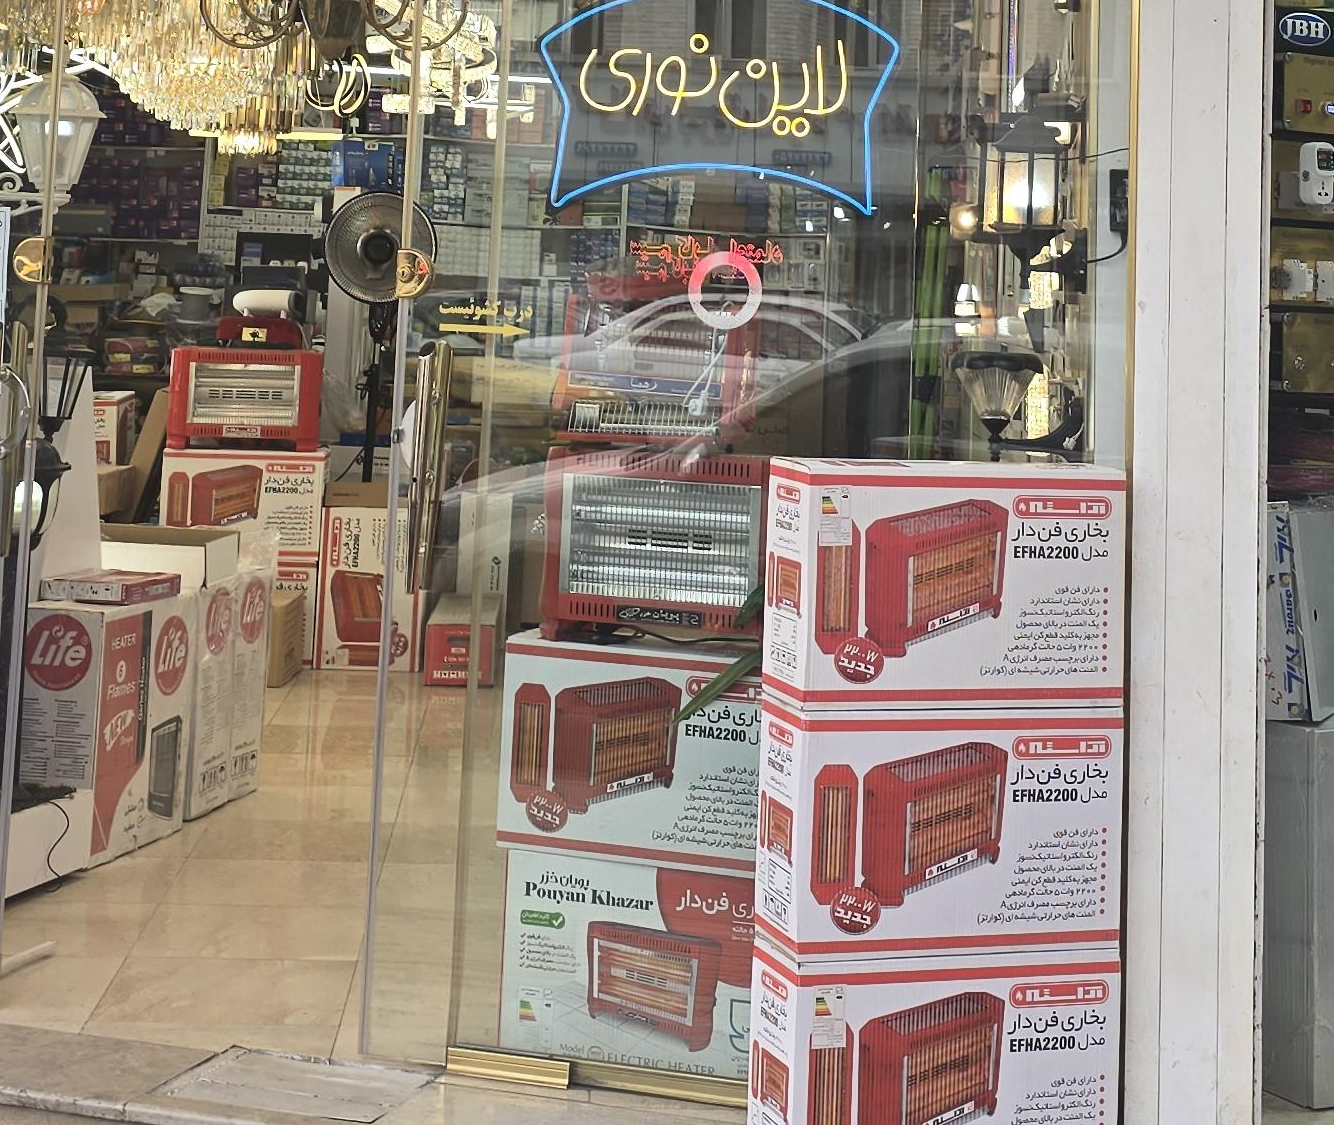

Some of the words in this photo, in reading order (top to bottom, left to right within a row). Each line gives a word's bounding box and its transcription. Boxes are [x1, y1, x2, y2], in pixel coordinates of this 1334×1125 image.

[1283, 18, 1325, 39] JBH
[580, 33, 718, 117] نوری
[720, 40, 847, 137] لاین
[291, 477, 314, 487] بخاری
[1065, 523, 1109, 543] بخاری
[1014, 545, 1079, 559] EFHA2200
[1082, 546, 1108, 561] مدل
[1082, 586, 1100, 594] دارای
[243, 588, 264, 625] Life
[1082, 598, 1100, 606] دارای
[31, 626, 86, 666] Life
[111, 632, 137, 650] HEATER
[158, 628, 187, 674] Life
[838, 656, 876, 679] جدید
[107, 681, 138, 701] Flames
[685, 724, 746, 742] EFHA2200
[1064, 763, 1108, 784] بخاری
[1013, 789, 1078, 802] EFHA2200
[1081, 787, 1107, 803] مدل
[560, 875, 590, 890] پویان
[524, 881, 586, 905] Pouyan
[590, 889, 654, 911] Khazar
[834, 907, 871, 929] جدید
[1061, 1009, 1106, 1031] بخاری
[559, 1043, 585, 1054] Model
[1010, 1036, 1075, 1053] EFHA2200
[1078, 1034, 1105, 1050] مدل
[607, 1053, 664, 1069] ELECTRIC
[668, 1059, 715, 1076] HEATER
